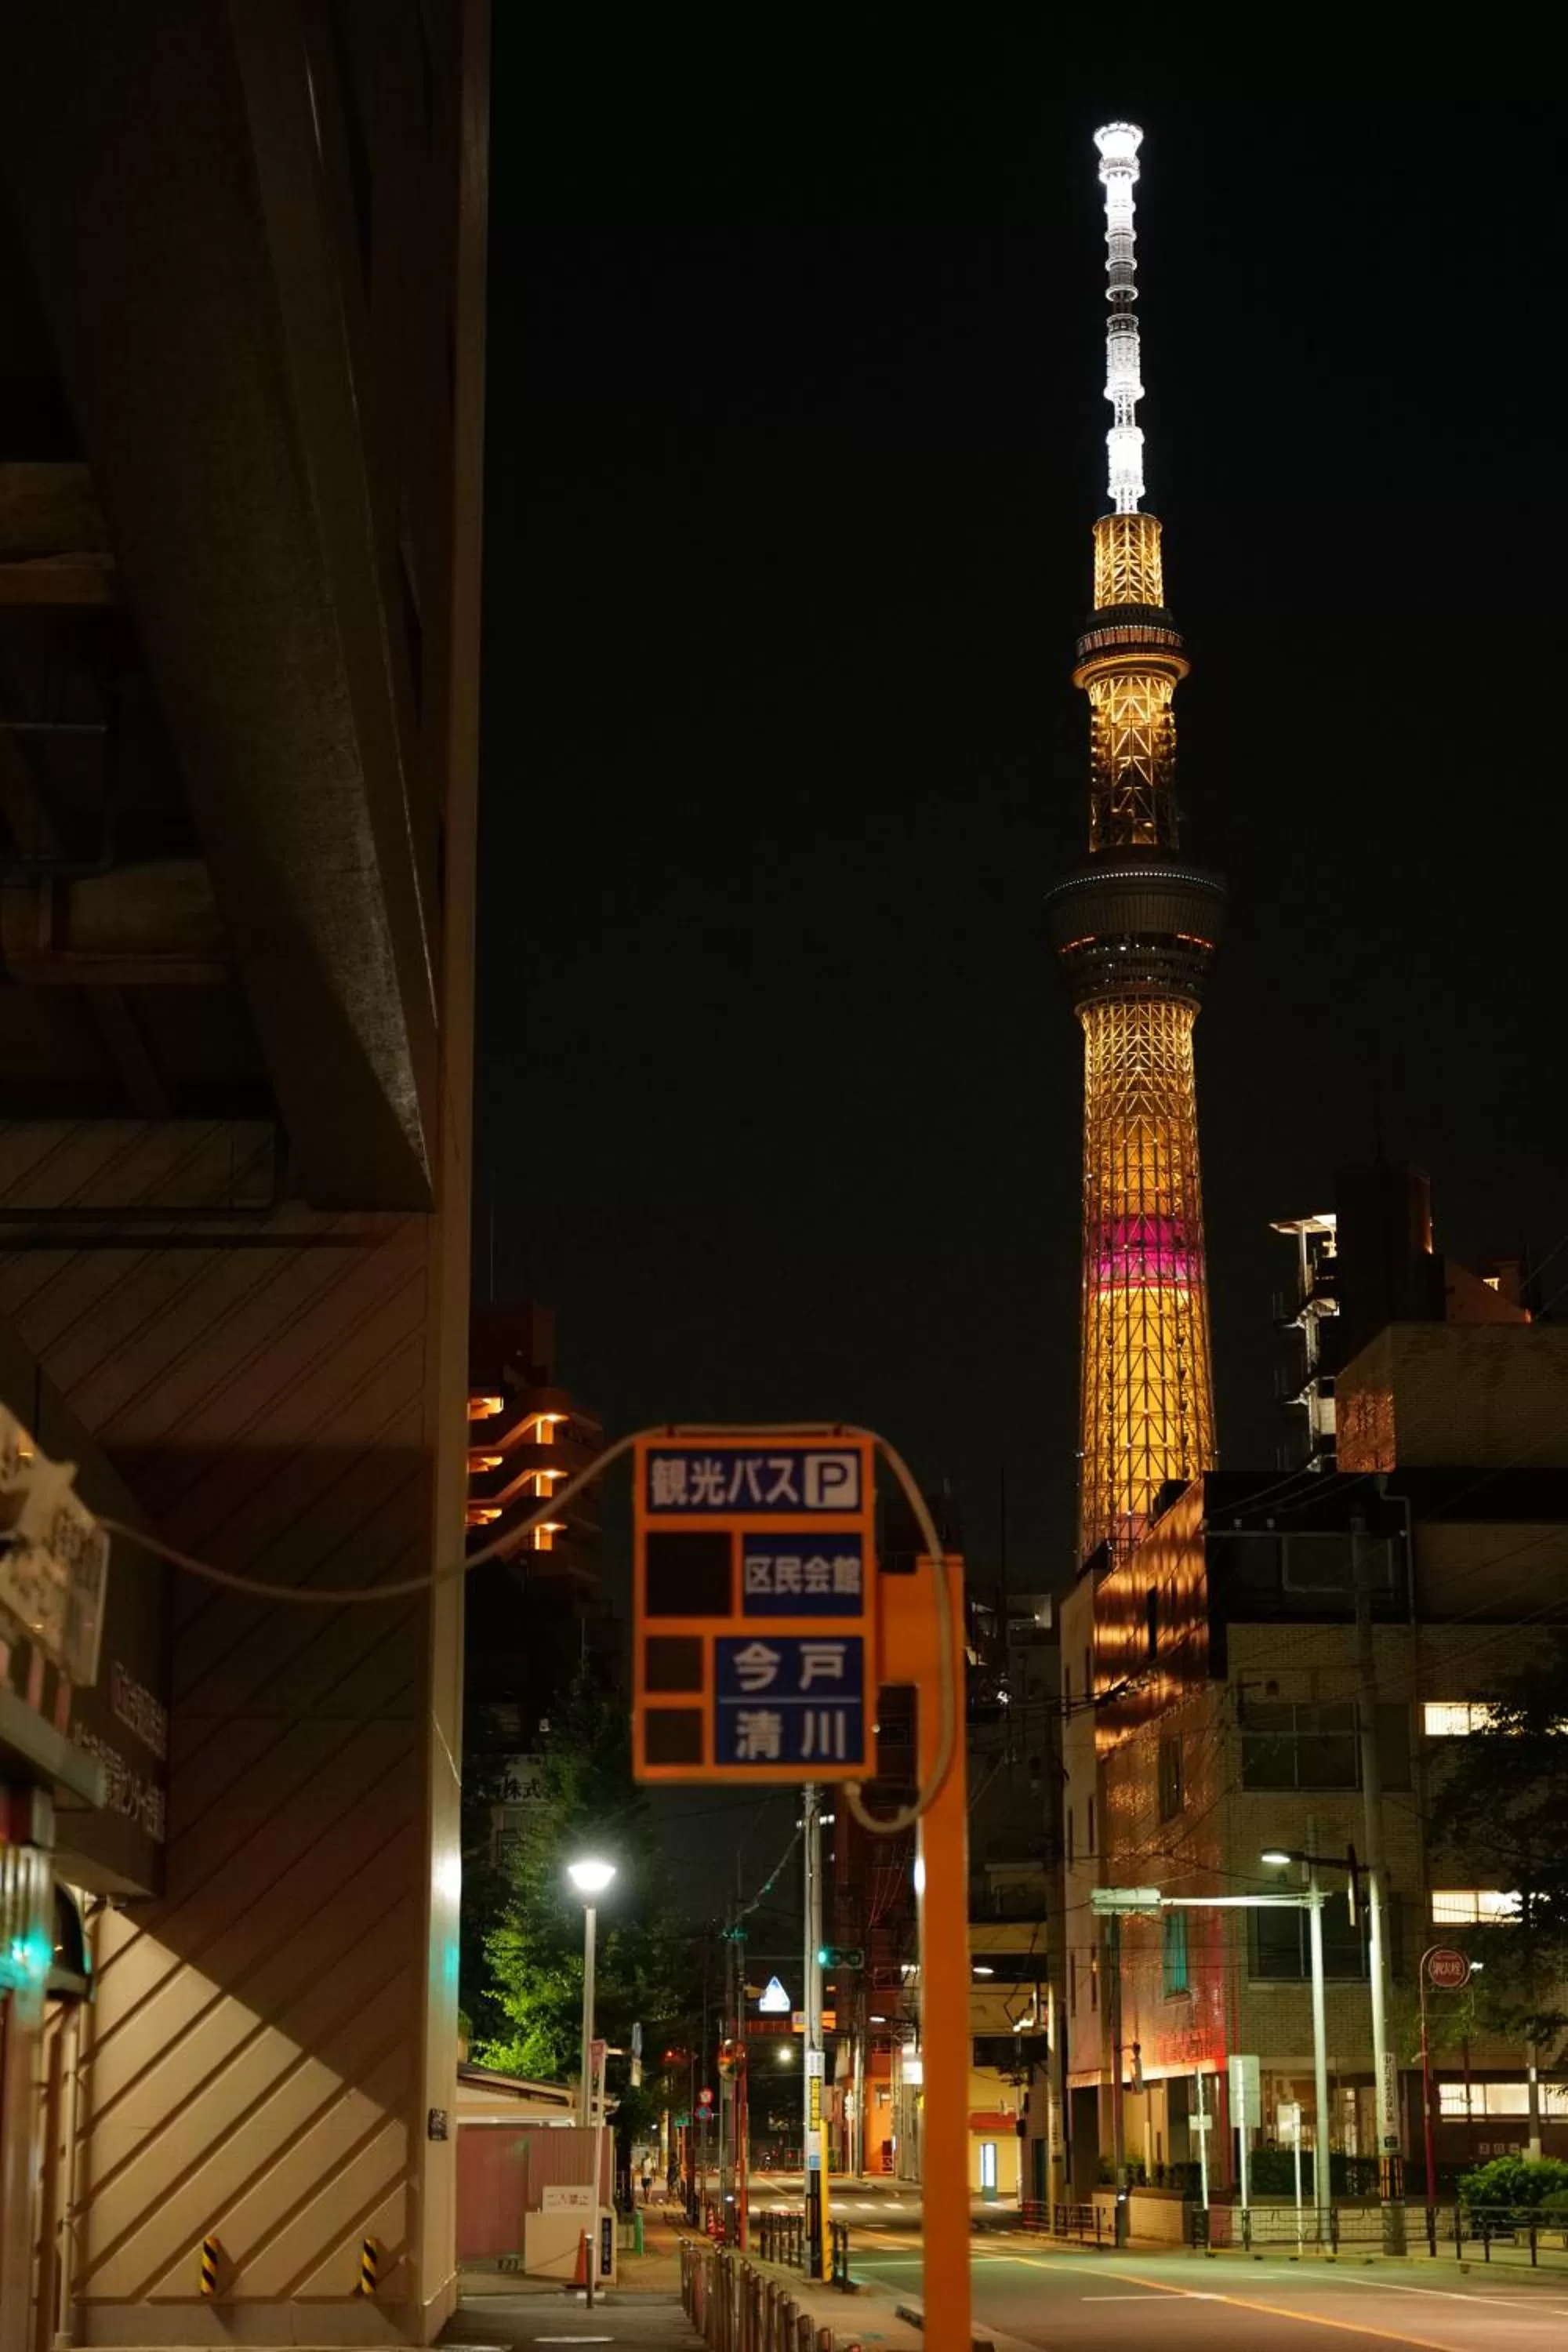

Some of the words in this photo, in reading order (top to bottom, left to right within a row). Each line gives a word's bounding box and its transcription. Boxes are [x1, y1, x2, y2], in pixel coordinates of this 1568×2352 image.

[651, 1457, 800, 1506] 観光バス
[745, 1555, 861, 1594] 区民会館
[733, 1641, 847, 1690] 今戸
[735, 1711, 846, 1759] 清川
